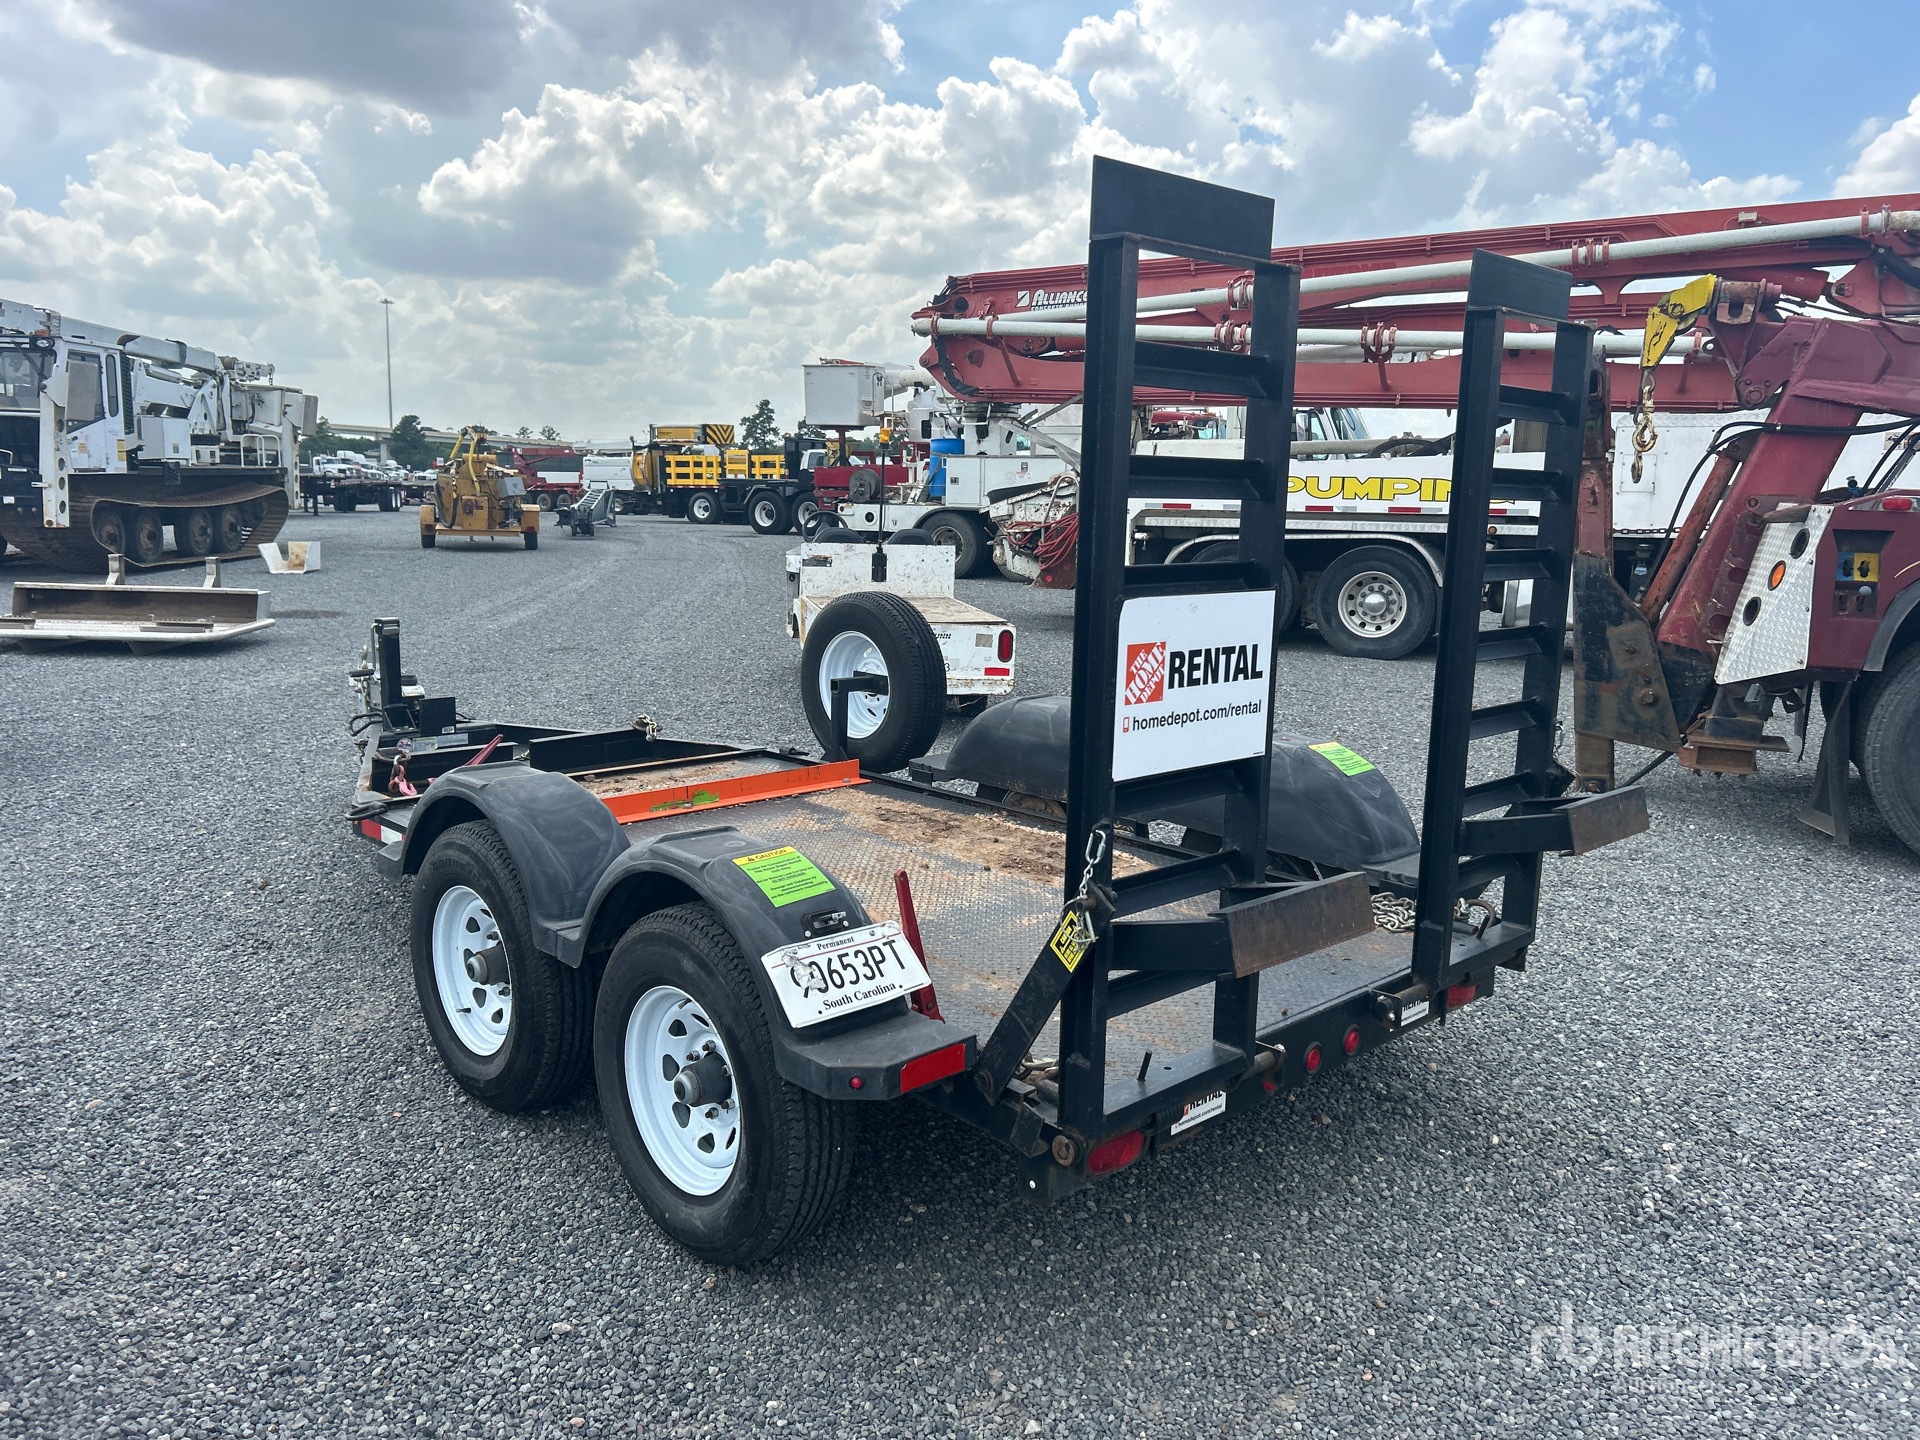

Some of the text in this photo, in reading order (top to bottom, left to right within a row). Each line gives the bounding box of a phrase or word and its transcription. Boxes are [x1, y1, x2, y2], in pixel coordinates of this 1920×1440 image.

[1125, 642, 1166, 705] HOME
[1129, 649, 1148, 675] THE
[1167, 643, 1264, 690] RENTAL
[1139, 664, 1165, 703] DEPOT
[1132, 699, 1262, 731] homedepot.com/rental
[755, 849, 787, 860] CAUTION
[817, 936, 855, 950] Permanent
[823, 982, 897, 1010] South Carolina
